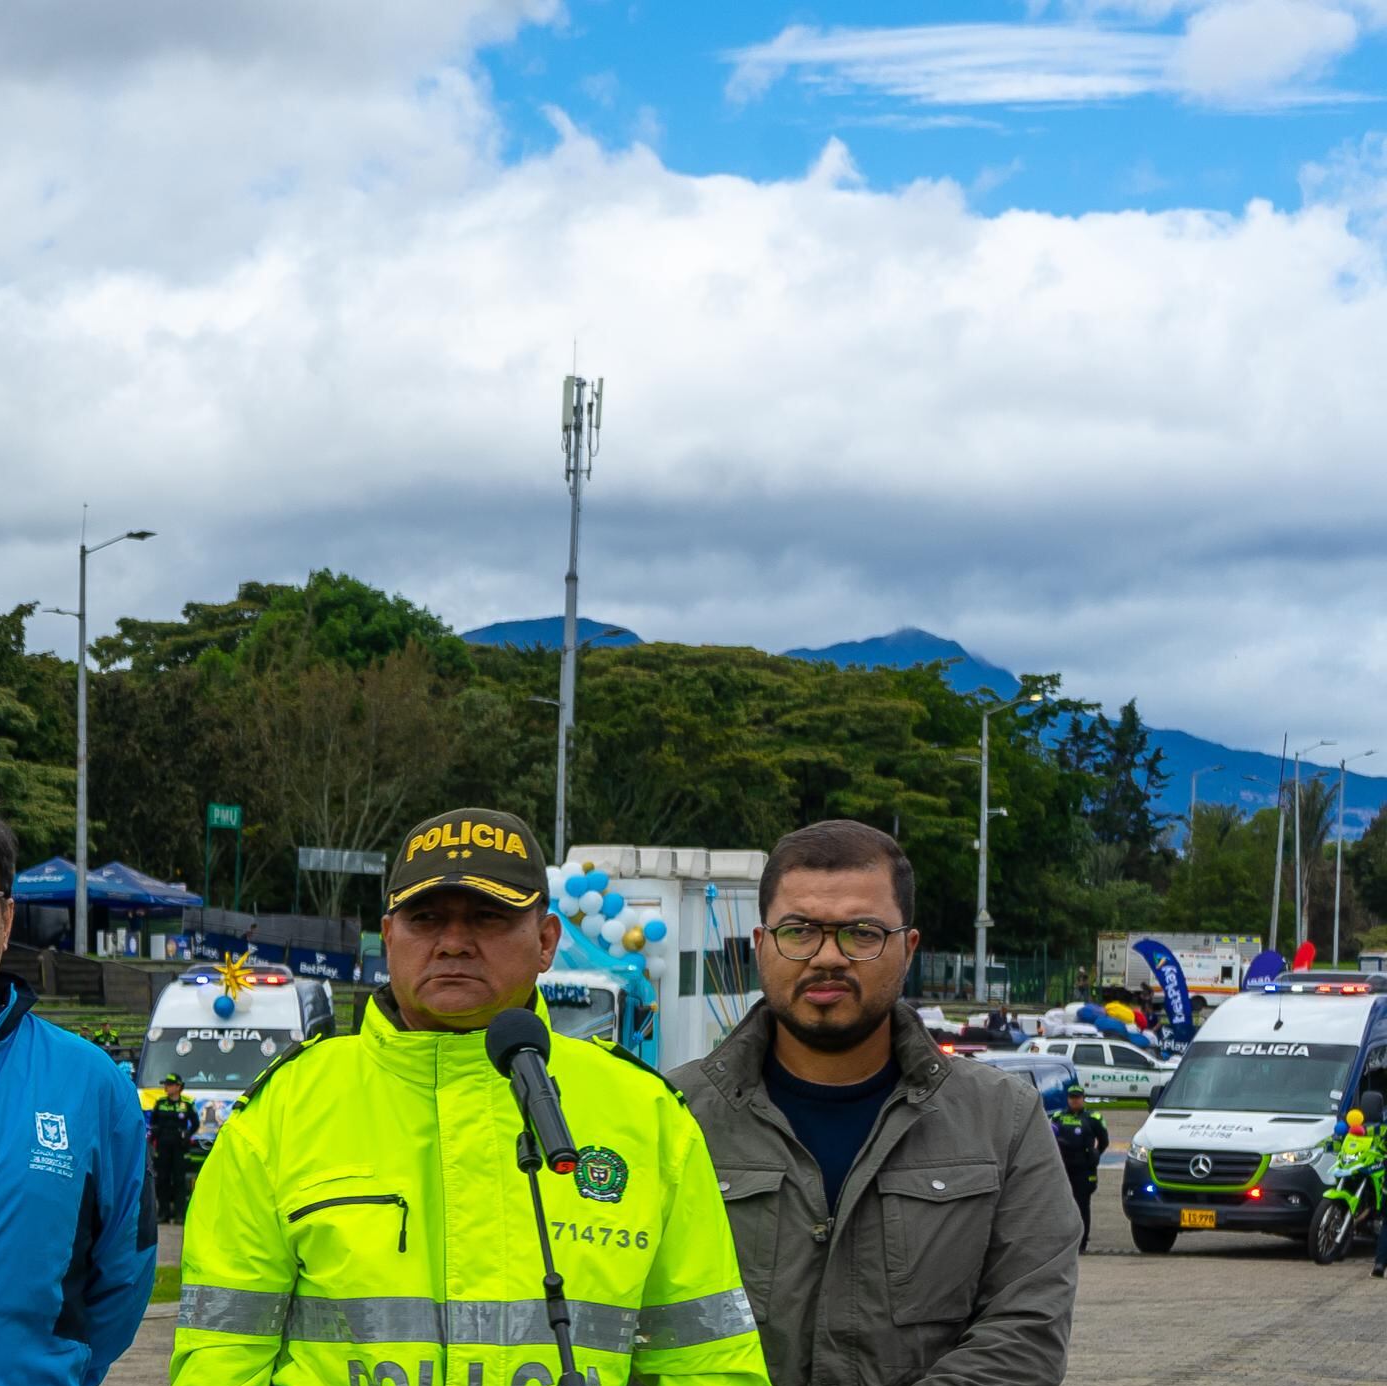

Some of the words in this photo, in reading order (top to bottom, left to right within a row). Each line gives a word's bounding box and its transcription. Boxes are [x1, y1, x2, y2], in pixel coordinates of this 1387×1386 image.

[406, 821, 528, 863] POLICIA
[299, 961, 338, 978] BetPlay
[187, 1028, 262, 1041] POLICÍA
[1226, 1043, 1310, 1057] POLICÍA
[551, 1221, 649, 1250] 714736
